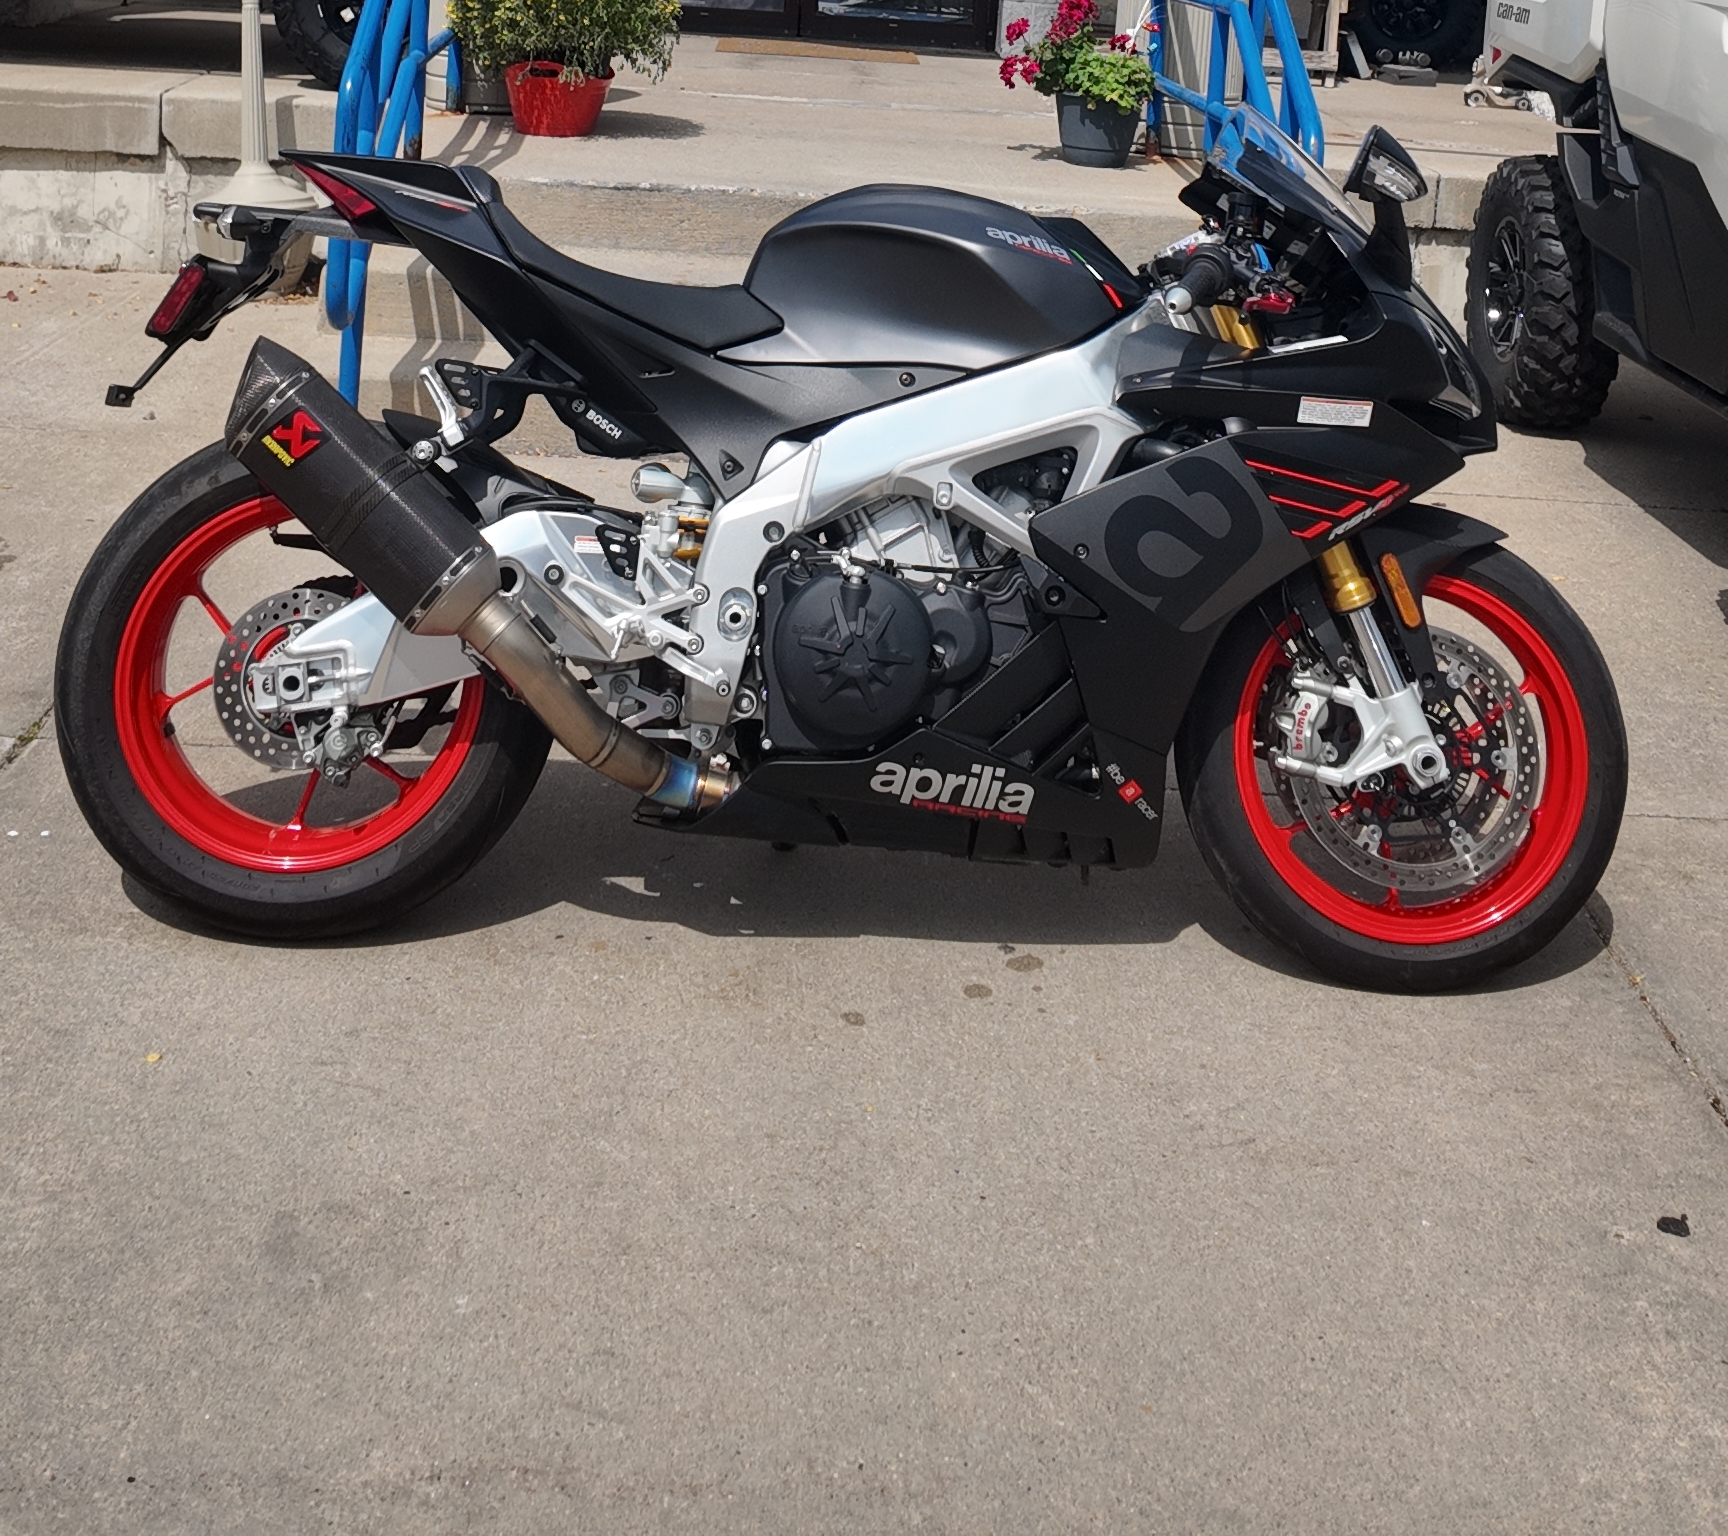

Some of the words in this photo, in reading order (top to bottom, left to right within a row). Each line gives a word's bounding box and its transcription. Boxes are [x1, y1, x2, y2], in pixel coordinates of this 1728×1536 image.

[1496, 2, 1530, 25] can-am
[985, 227, 1071, 261] aprilia
[586, 409, 622, 440] BOSCH
[1293, 702, 1312, 751] brembo
[869, 761, 1035, 815] aprilia
[1105, 763, 1126, 785] #be
[1134, 797, 1159, 821] racer
